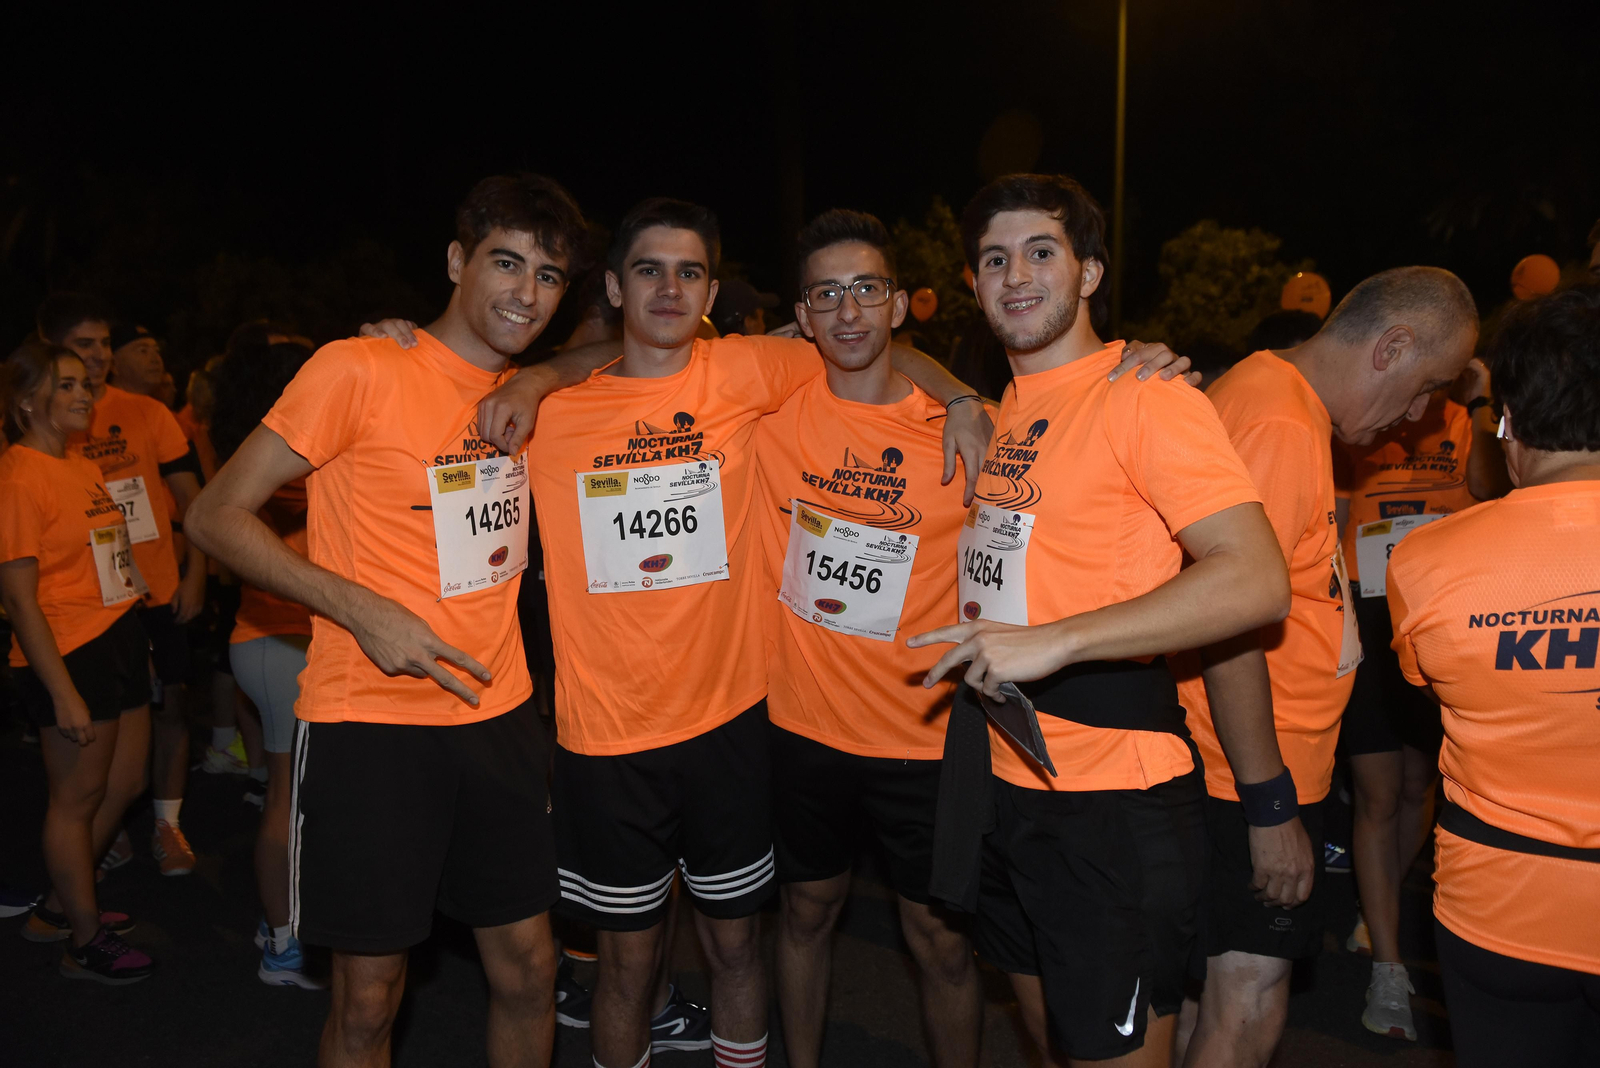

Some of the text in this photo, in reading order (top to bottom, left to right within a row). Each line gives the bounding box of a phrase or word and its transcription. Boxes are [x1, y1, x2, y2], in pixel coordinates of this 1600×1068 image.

[627, 432, 704, 450] NOCTURNA
[592, 449, 663, 469] SEVILLA
[1378, 463, 1427, 471] SEVILLA
[1403, 455, 1459, 465] NOCTURNA
[802, 471, 863, 498] SEVILLA
[832, 468, 907, 489] NOCTURNA
[465, 496, 520, 536] 14265
[612, 504, 698, 541] 14266
[865, 542, 891, 552] SEVILLA
[879, 540, 907, 549] NOCTURNA
[806, 550, 883, 594] 15456
[963, 546, 1004, 592] 14264
[1468, 607, 1600, 629] NOCTURNA
[1494, 627, 1600, 671] KH
